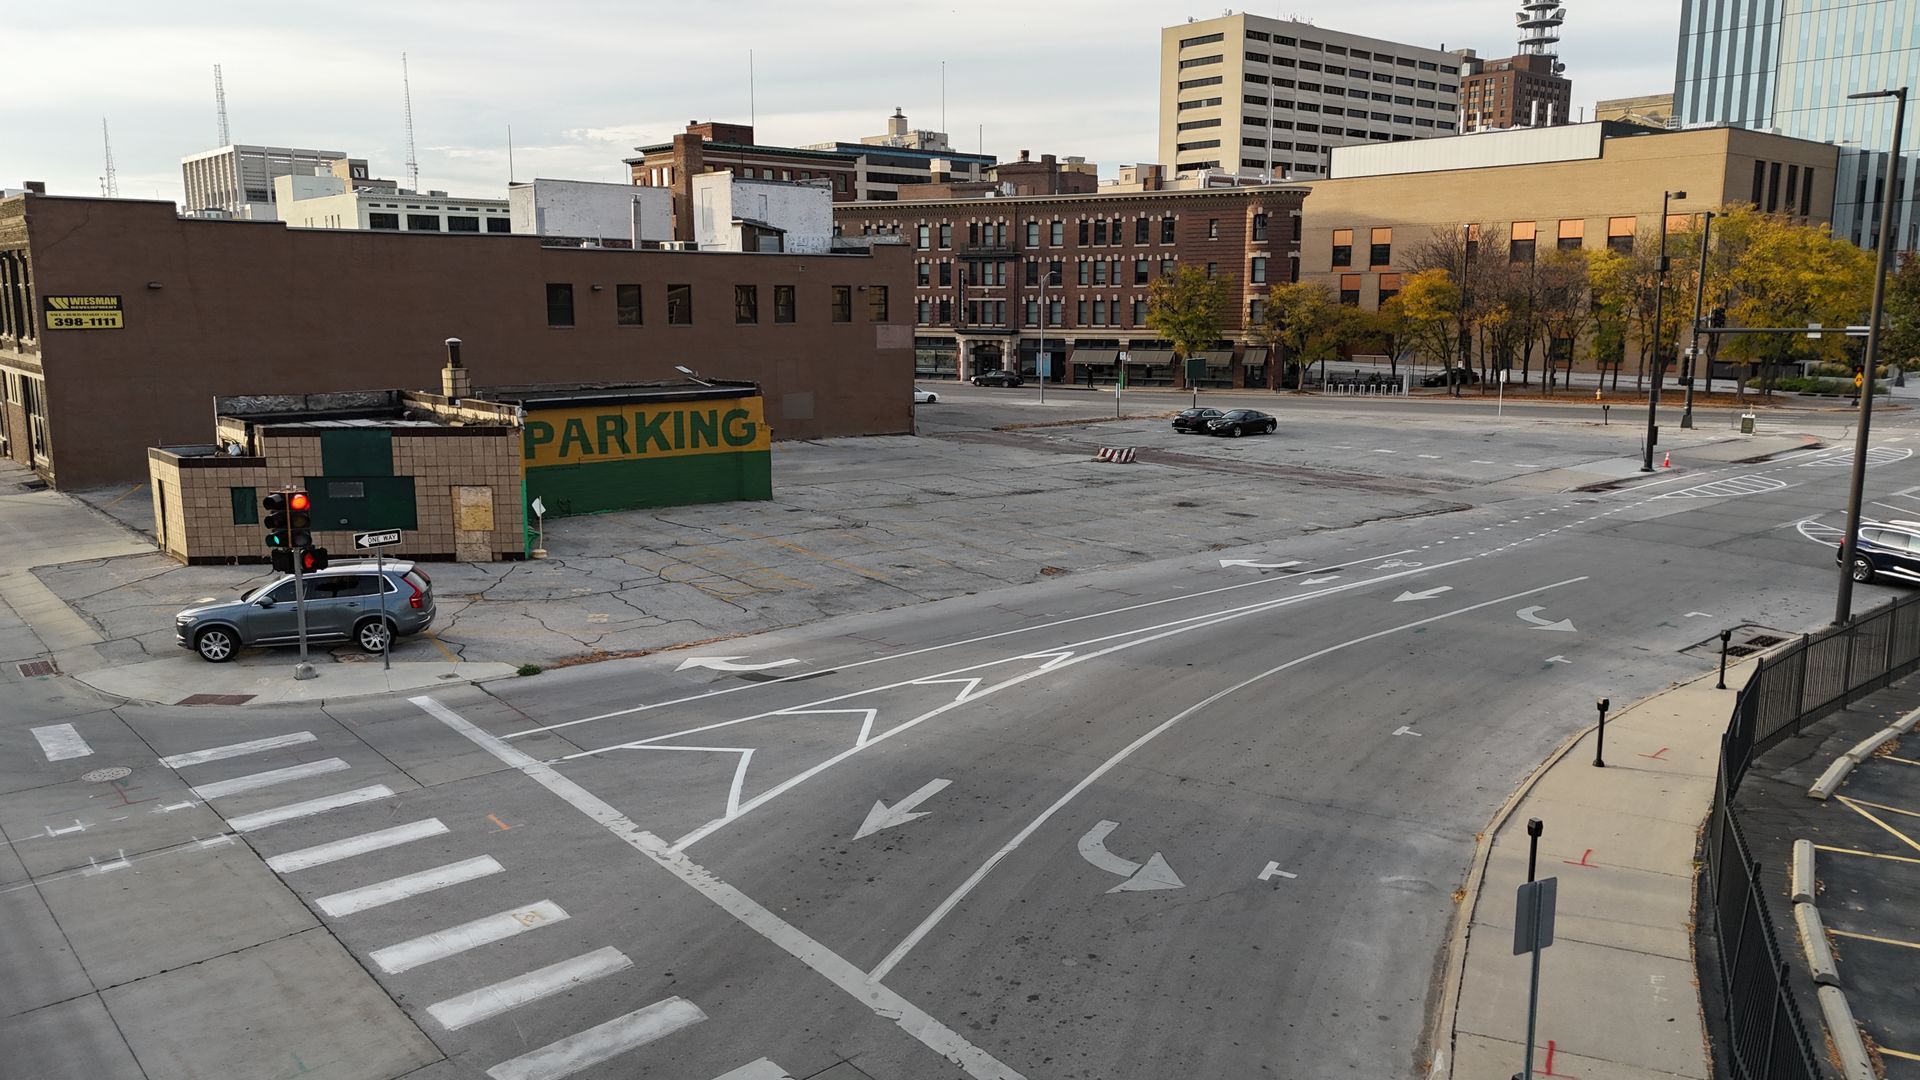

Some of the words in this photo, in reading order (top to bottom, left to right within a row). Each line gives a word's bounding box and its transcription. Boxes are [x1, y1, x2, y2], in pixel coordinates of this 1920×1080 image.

[69, 297, 118, 305] WIESMAN
[54, 317, 117, 326] 398-1111
[524, 408, 757, 460] PARKING
[368, 536, 380, 544] ONE
